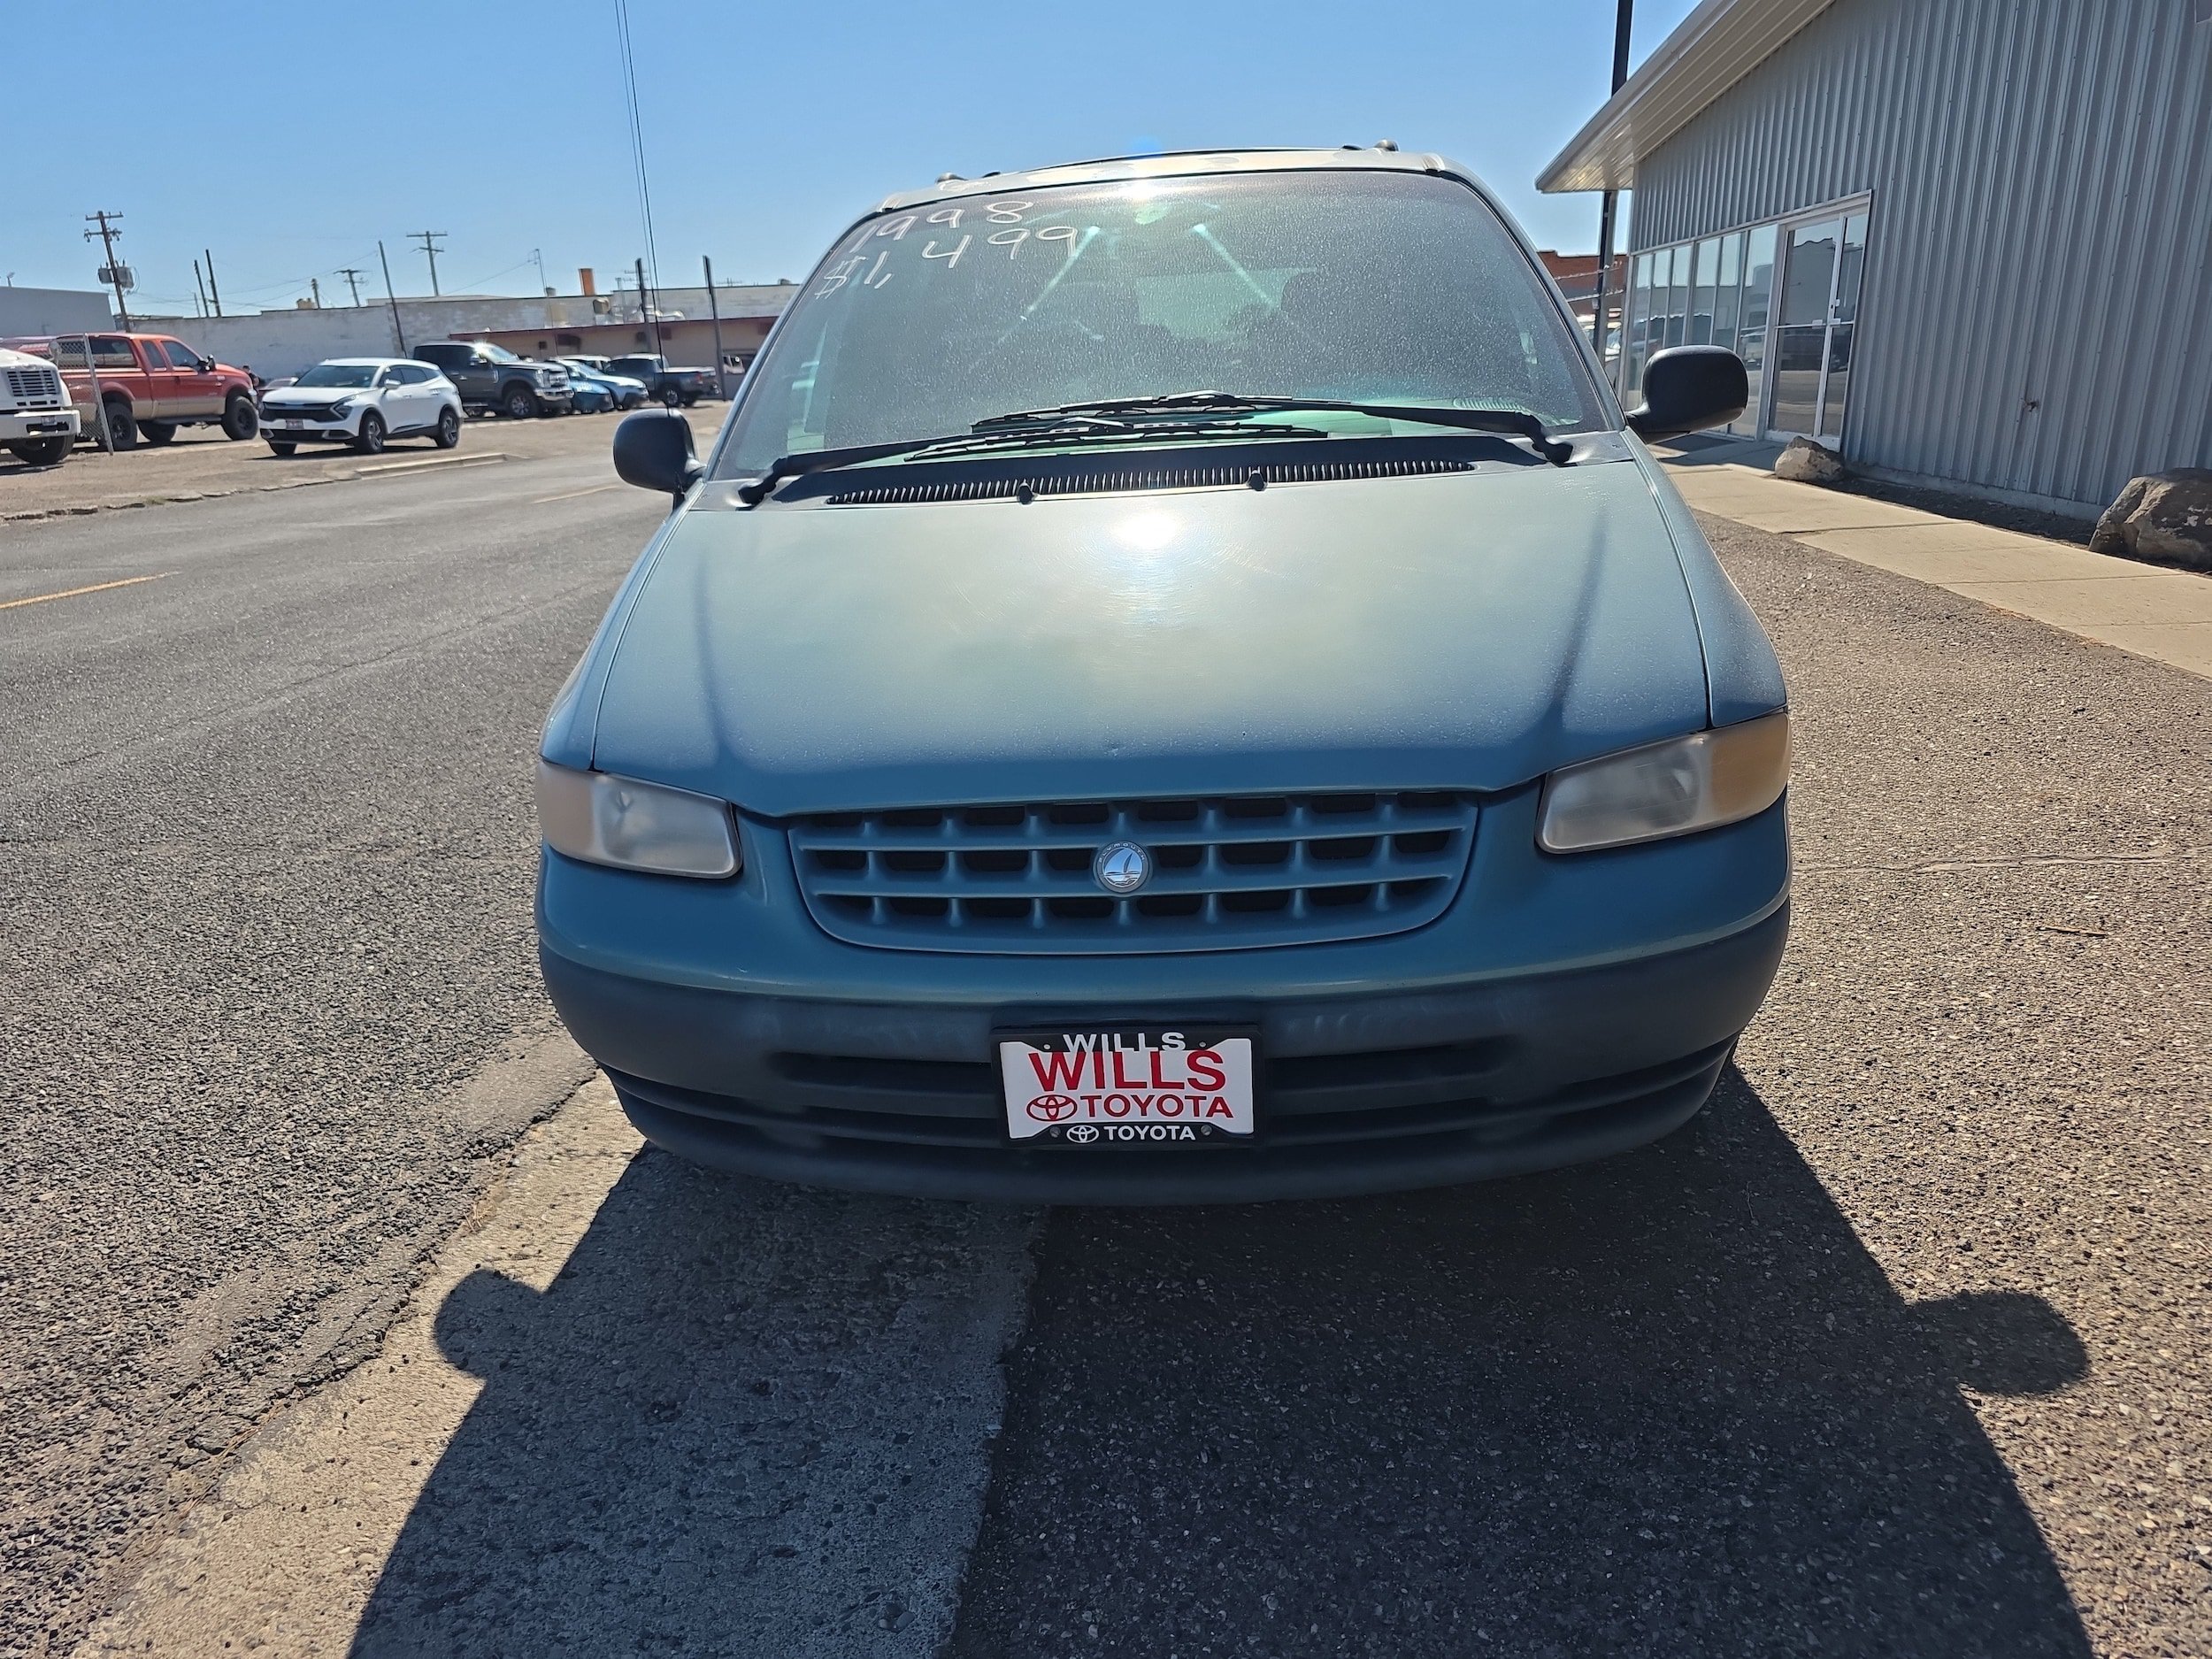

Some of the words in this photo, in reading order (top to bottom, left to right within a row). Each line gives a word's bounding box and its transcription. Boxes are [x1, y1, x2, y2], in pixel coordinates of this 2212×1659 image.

[849, 201, 1033, 253] 1998
[1063, 1032, 1187, 1052] WILLS
[1028, 1050, 1226, 1092] WILLS
[1079, 1094, 1234, 1118] TOYOTA
[1103, 1125, 1195, 1141] TOYOTA
